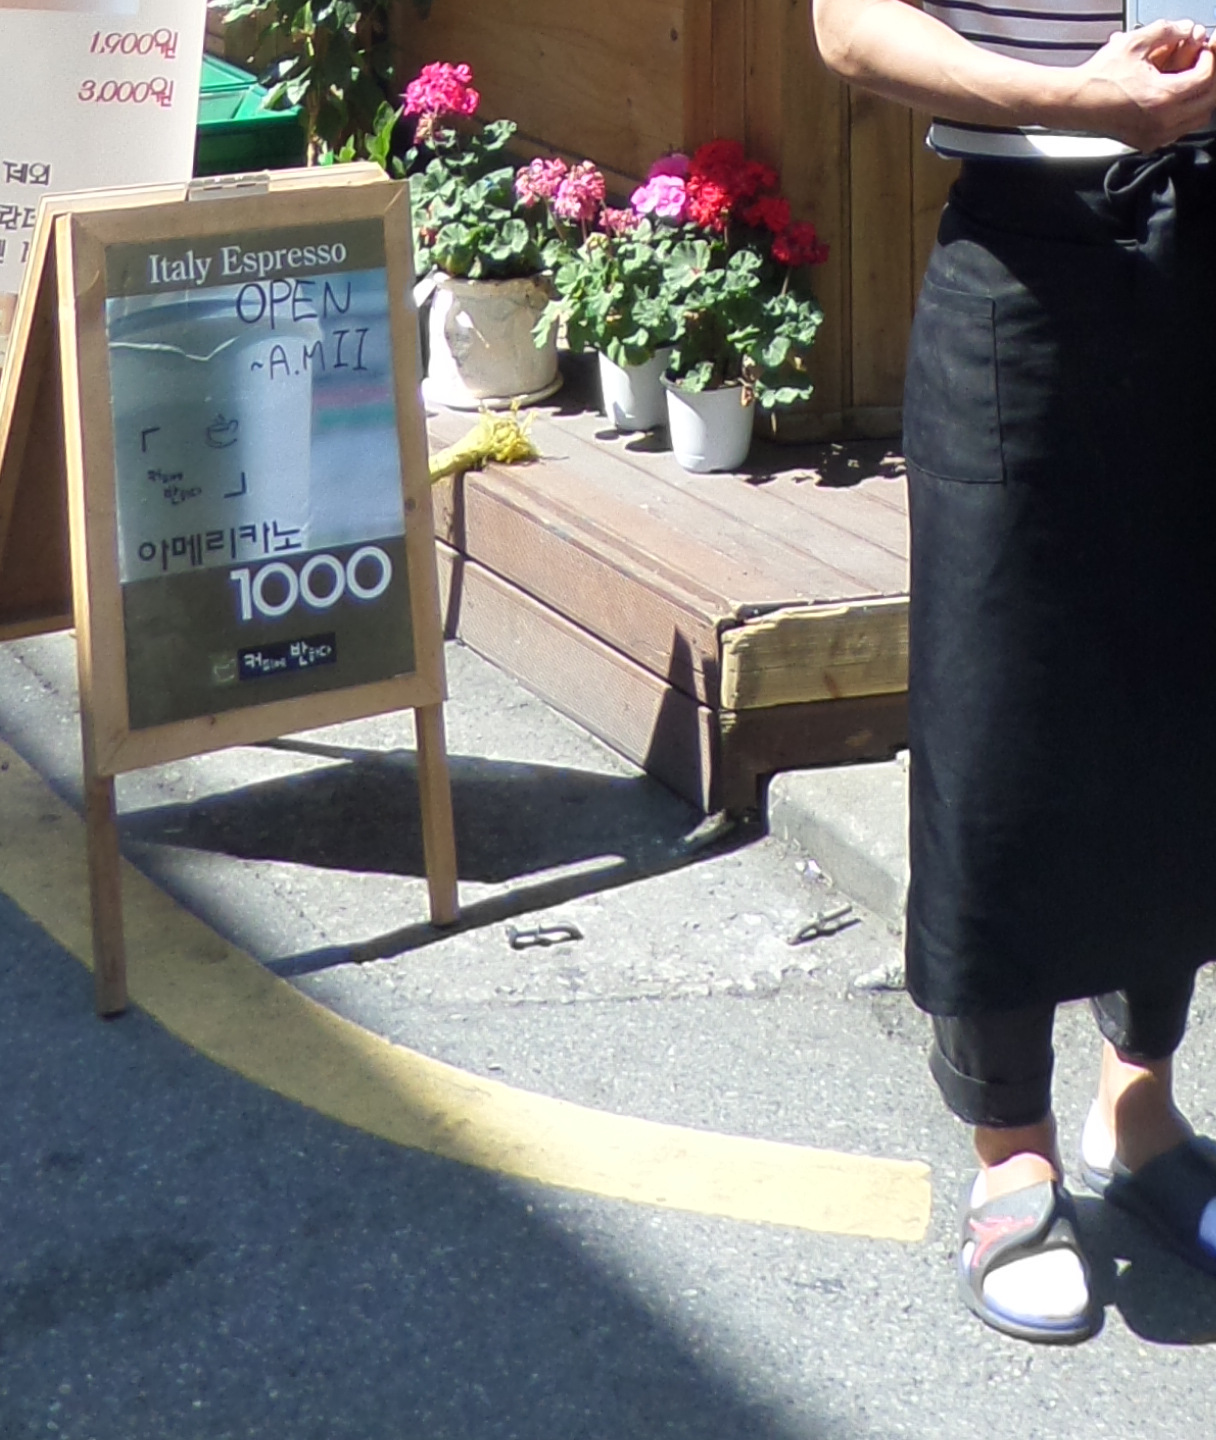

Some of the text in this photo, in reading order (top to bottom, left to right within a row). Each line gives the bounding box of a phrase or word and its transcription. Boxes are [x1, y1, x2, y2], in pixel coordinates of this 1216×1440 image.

[90, 28, 179, 59] 1.900원
[78, 77, 173, 107] 3.000원
[149, 239, 348, 285] Italy Espresso
[235, 279, 352, 330] OPEN
[138, 521, 302, 570] 아메리카노
[230, 545, 393, 620] 1000
